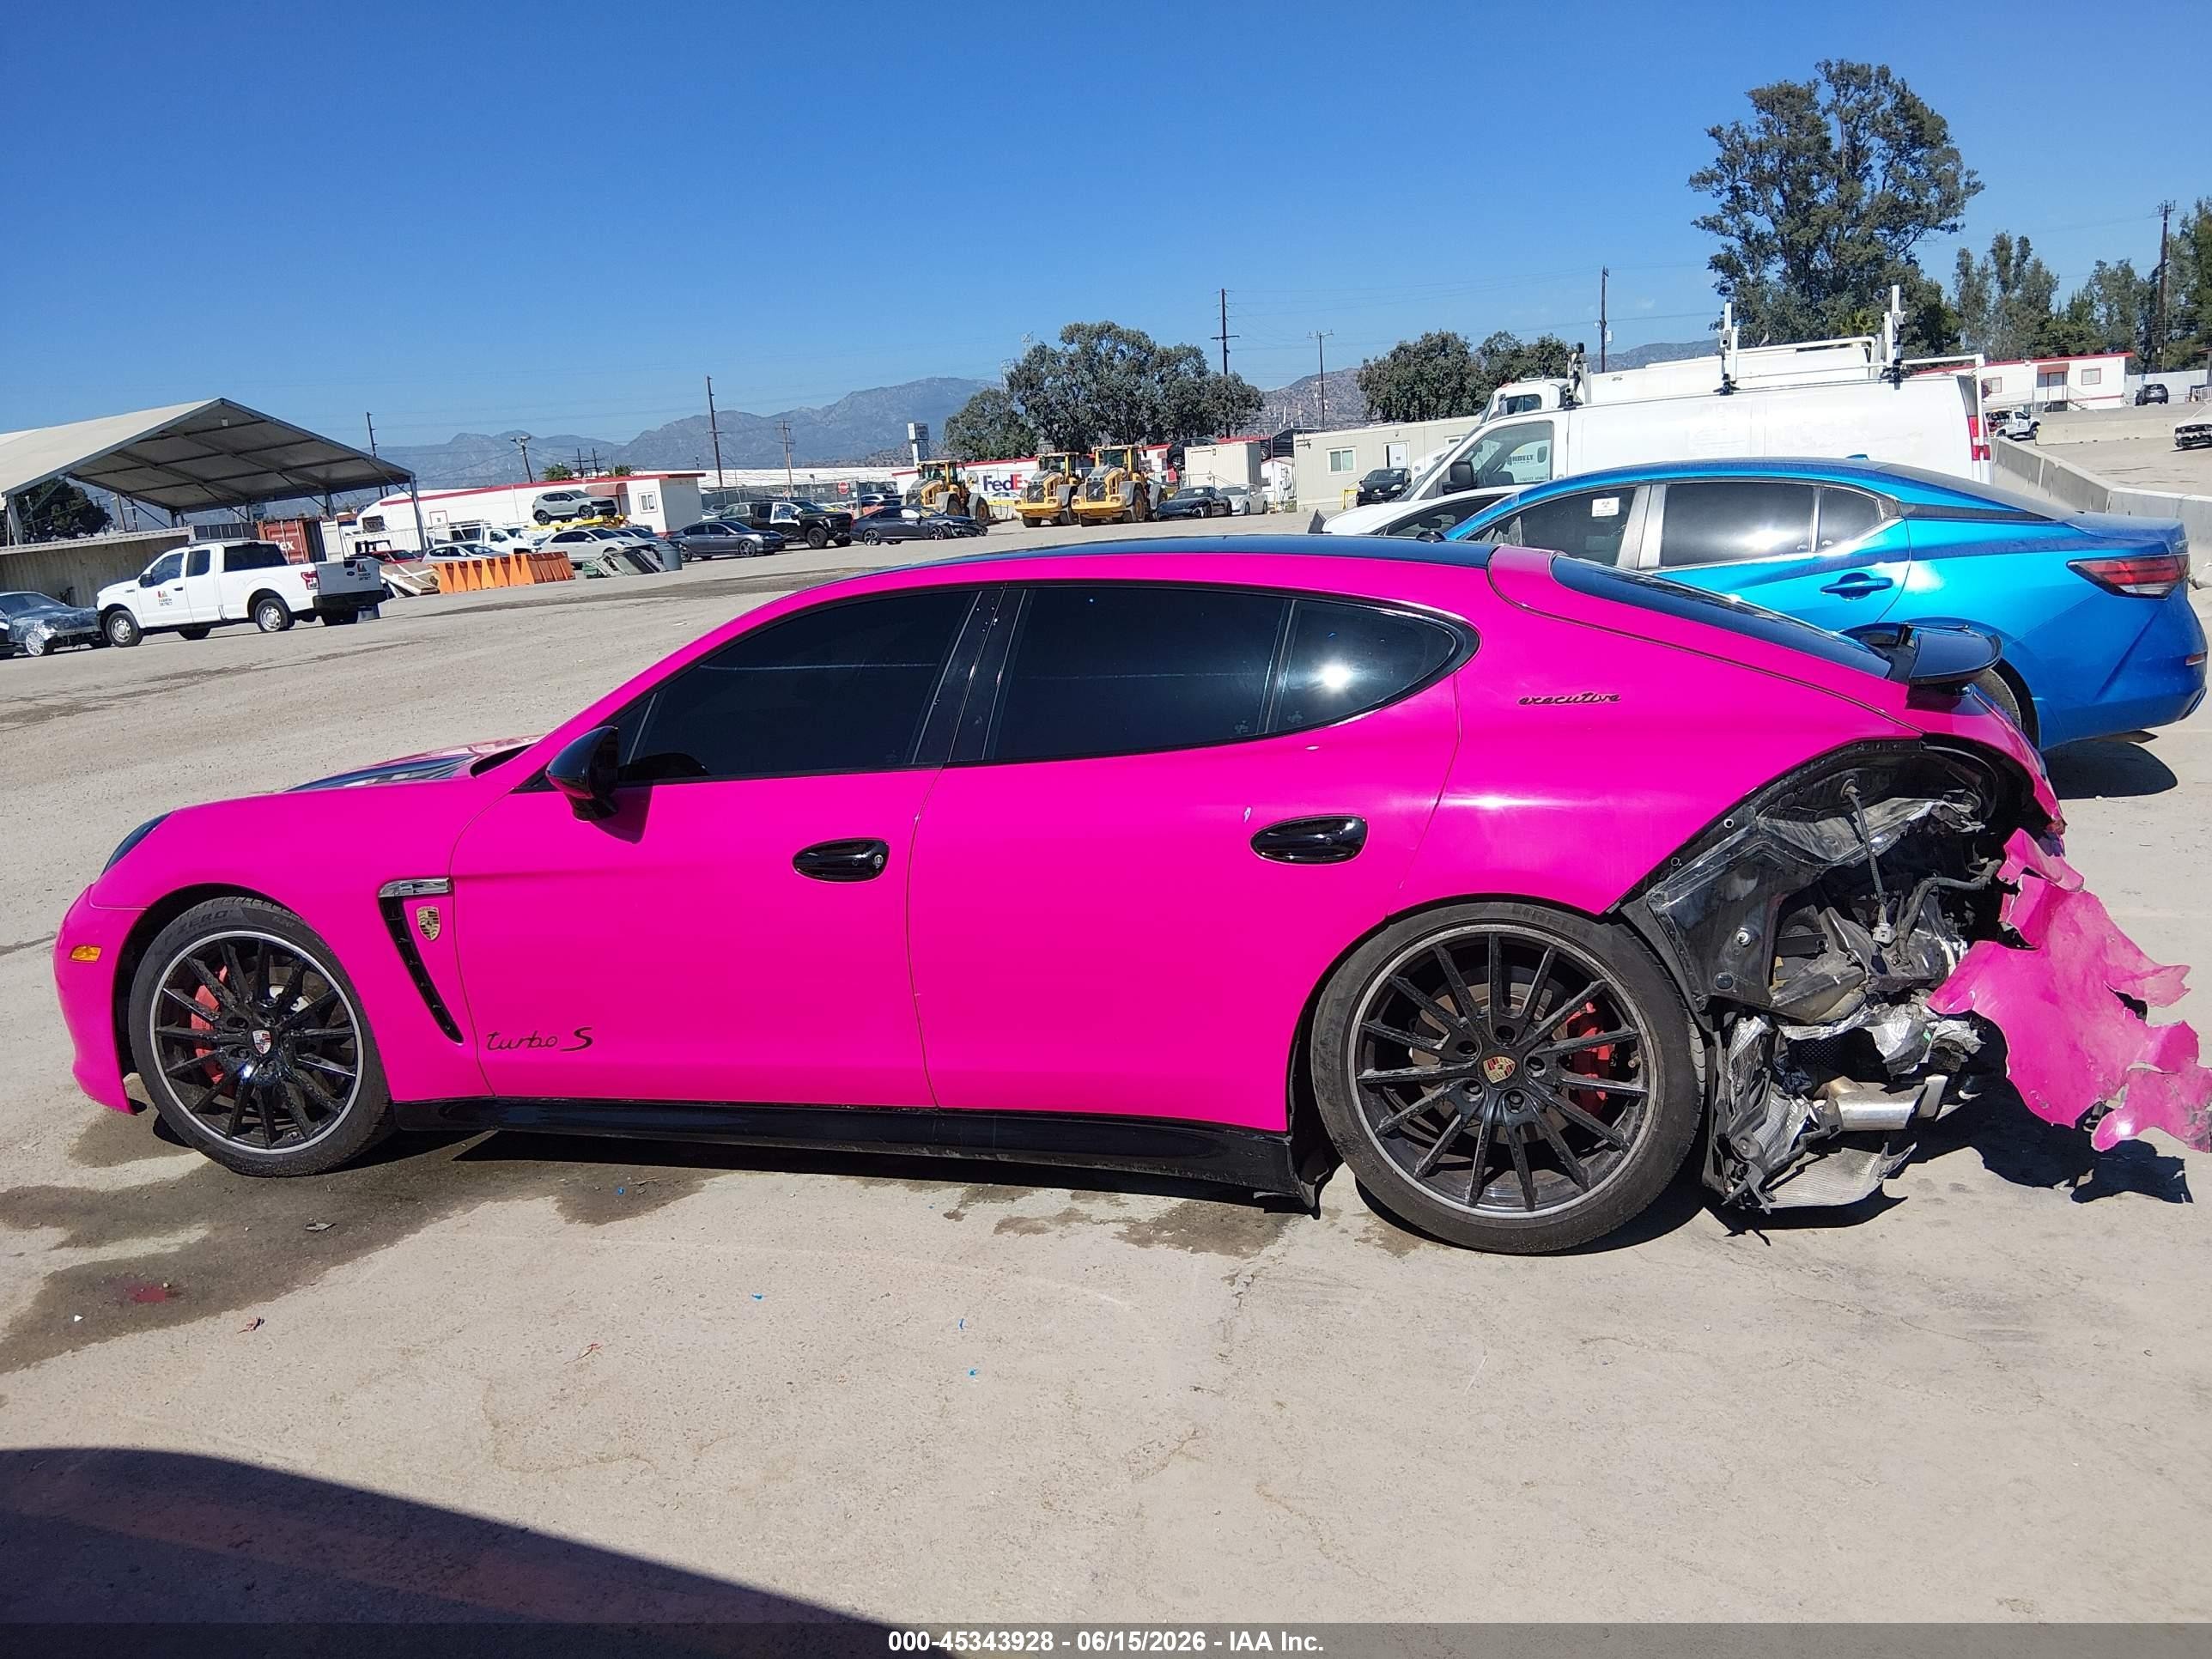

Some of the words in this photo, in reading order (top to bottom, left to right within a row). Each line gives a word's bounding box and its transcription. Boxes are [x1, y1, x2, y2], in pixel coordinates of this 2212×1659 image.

[1518, 692, 1620, 705] executive
[487, 1030, 558, 1050] turbo
[560, 1027, 592, 1051] S
